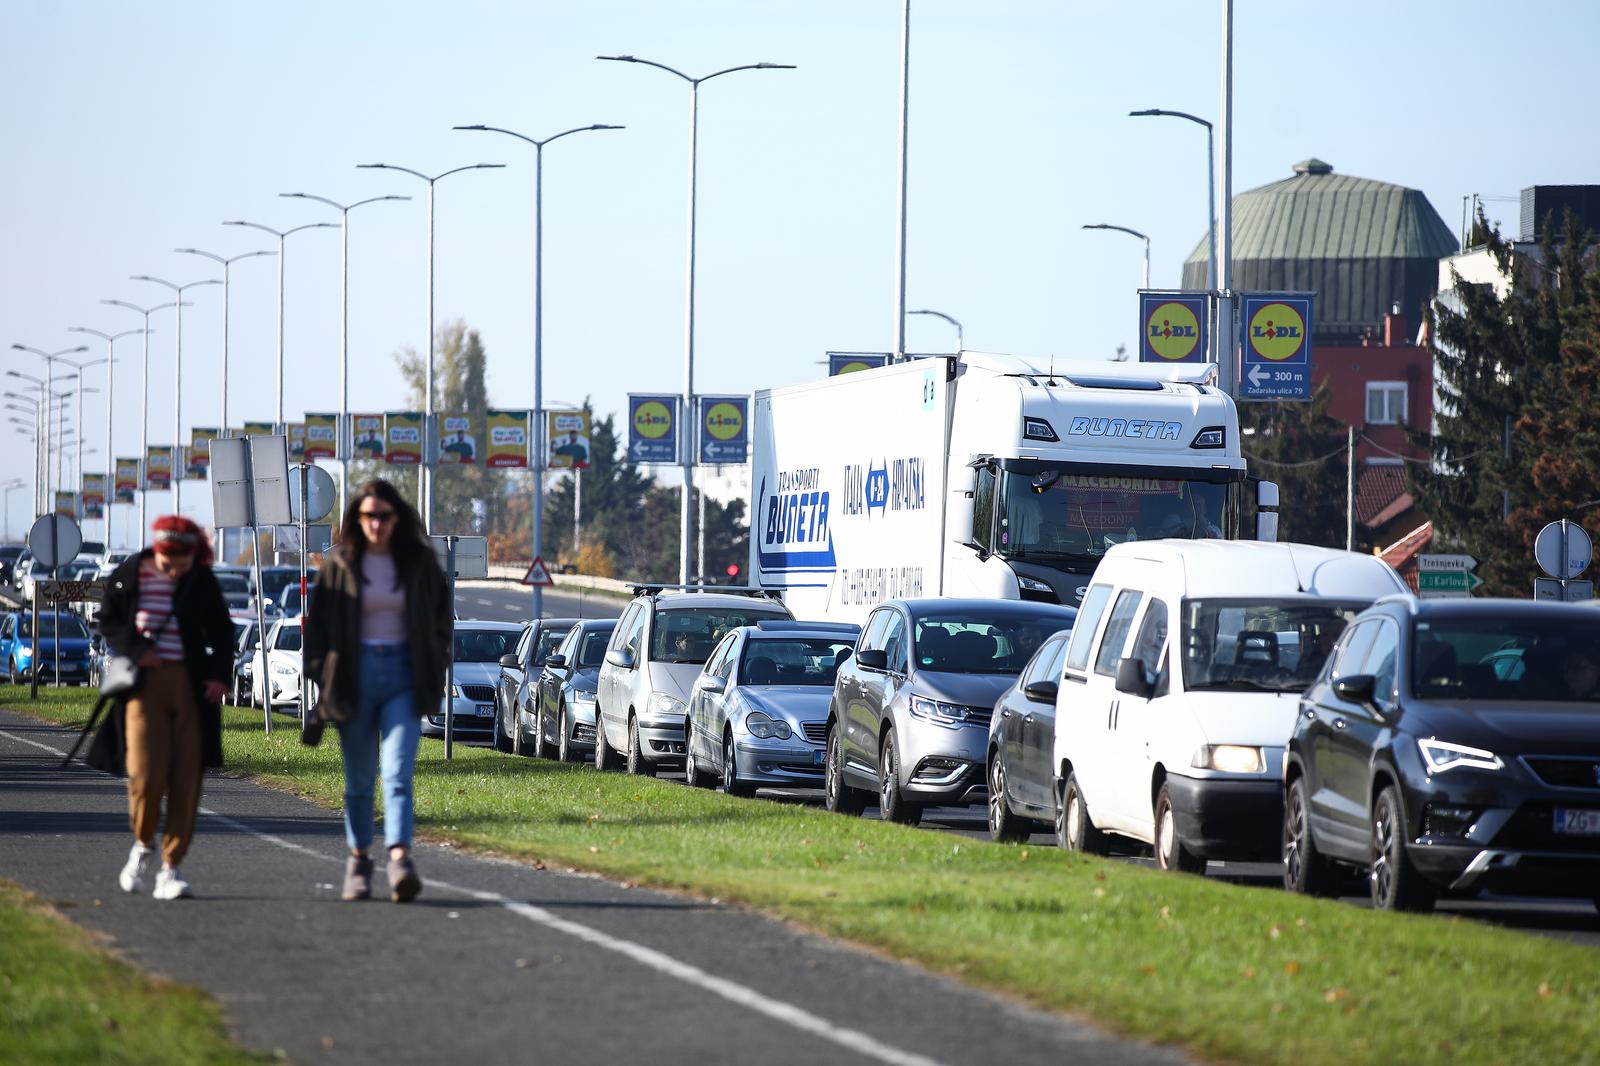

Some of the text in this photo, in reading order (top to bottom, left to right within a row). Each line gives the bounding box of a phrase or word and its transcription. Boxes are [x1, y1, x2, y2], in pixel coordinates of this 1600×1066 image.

[1274, 371, 1292, 381] 300
[1068, 416, 1183, 441] BUNETA
[778, 468, 820, 493] TRANSPORTI
[891, 456, 925, 511] HRVATSKA
[1062, 475, 1161, 491] MACEDONIA
[766, 491, 830, 545] BUNETA
[1069, 514, 1134, 525] MACEDONIA
[1424, 558, 1465, 568] Trešnjevka
[1568, 810, 1588, 830] ZG
